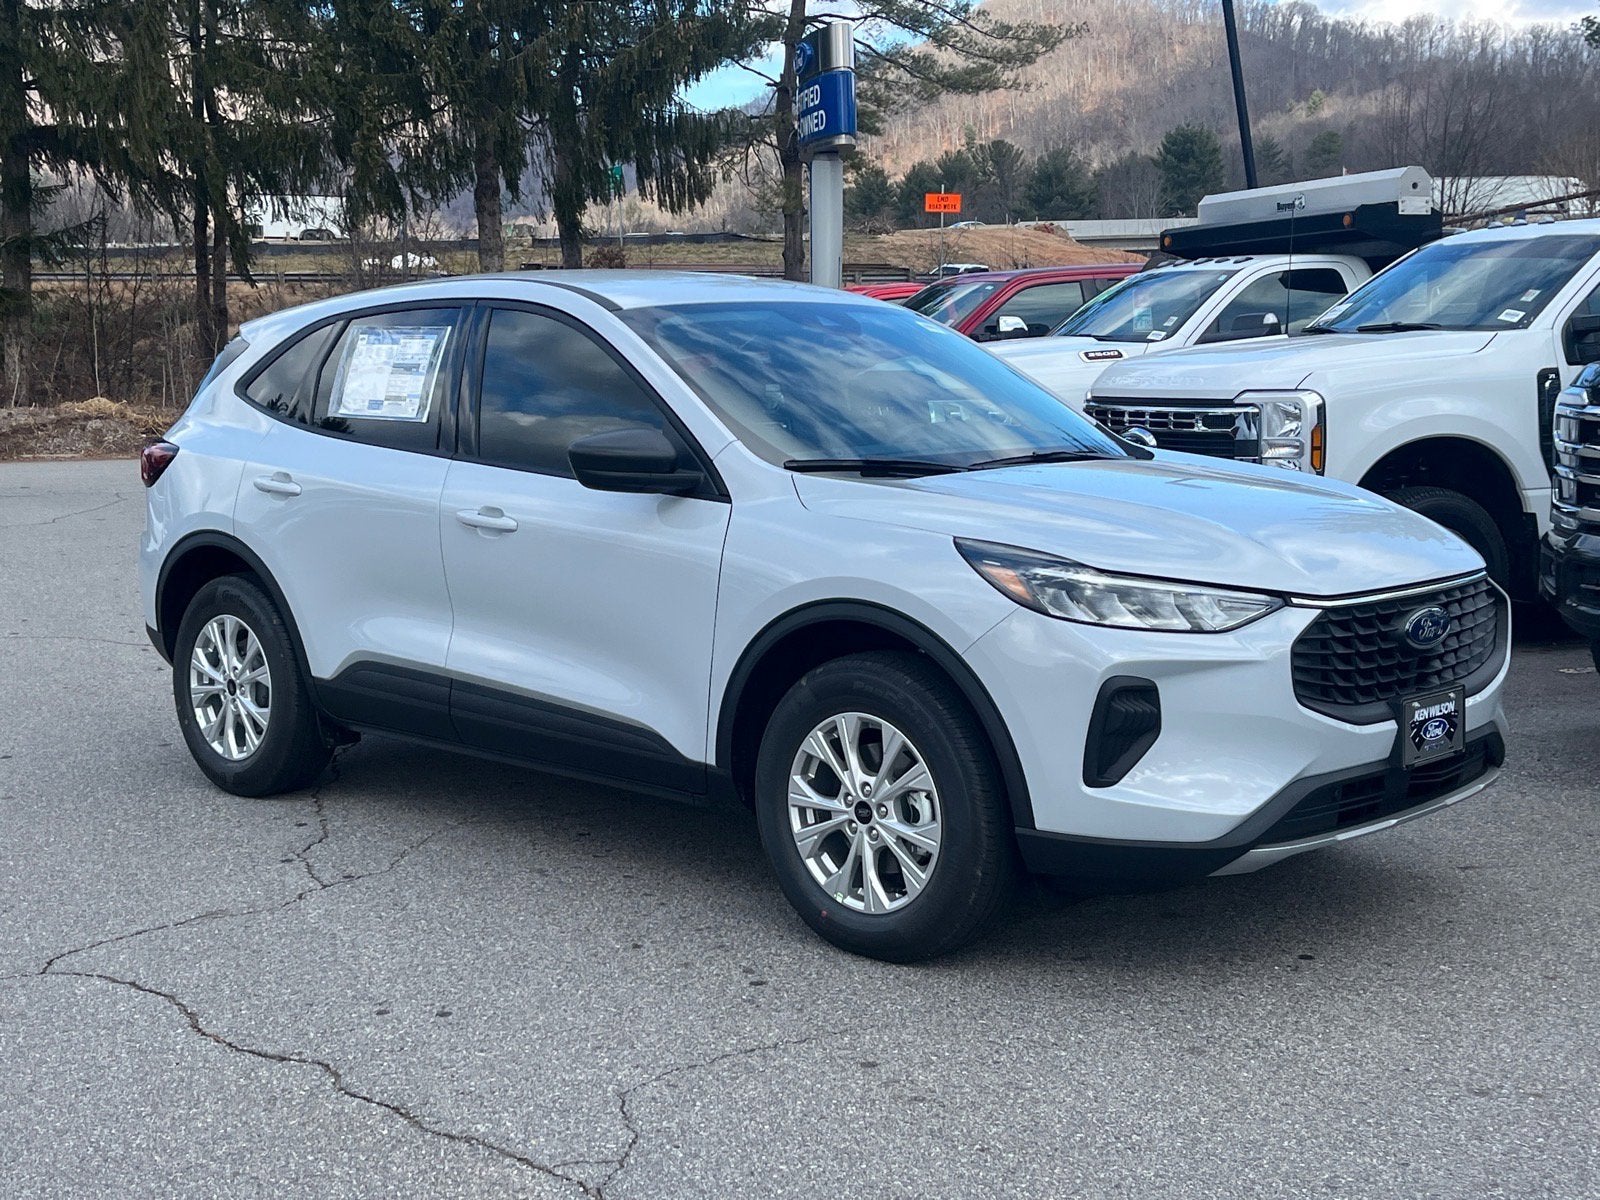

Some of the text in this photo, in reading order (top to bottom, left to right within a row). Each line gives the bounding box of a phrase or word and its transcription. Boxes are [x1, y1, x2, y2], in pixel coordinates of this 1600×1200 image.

[1418, 617, 1445, 641] Ford
[1414, 700, 1455, 721] KEN WILSON
[1426, 721, 1444, 738] Ford
